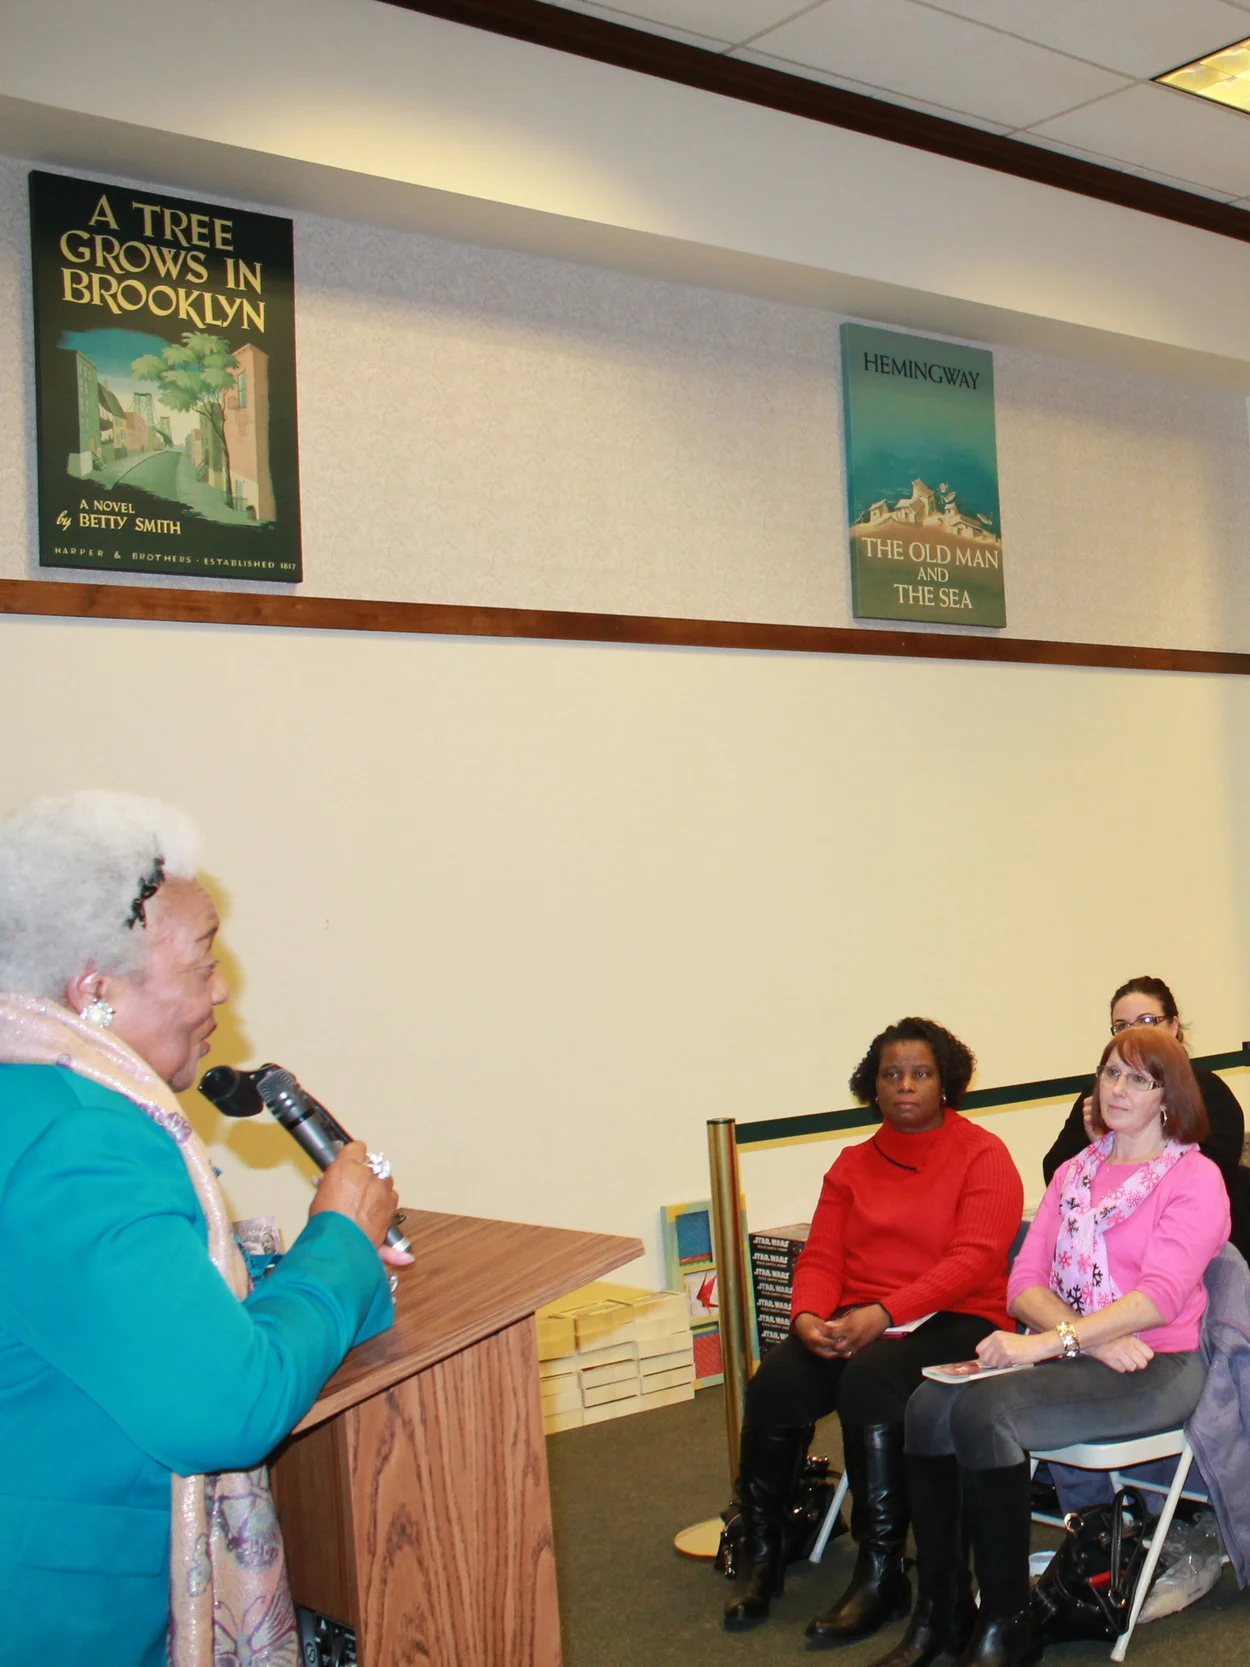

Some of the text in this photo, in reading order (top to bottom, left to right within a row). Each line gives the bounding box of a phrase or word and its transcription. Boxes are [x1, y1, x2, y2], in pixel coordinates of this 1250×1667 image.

[88, 194, 234, 252] A TREE
[60, 229, 263, 295] GROWS IN
[60, 267, 266, 334] BROOKLYN
[863, 352, 980, 391] HEMINGWAY
[80, 499, 136, 514] A NOVEL
[56, 510, 181, 535] by BETTY SMITH
[54, 547, 297, 570] HARPER & BROTHERS ESTABLISHED 1817
[861, 536, 998, 569] THE OLD MAN
[917, 566, 949, 583] AND
[893, 583, 973, 609] THE SEA
[754, 1237, 789, 1248] STAR WARS
[753, 1253, 789, 1264] STAR WARS
[755, 1269, 771, 1277] STAR
[771, 1271, 790, 1280] WARS
[758, 1283, 775, 1292] STAR
[758, 1300, 774, 1308] STAR
[759, 1315, 775, 1324] STAR
[762, 1331, 779, 1340] STAR
